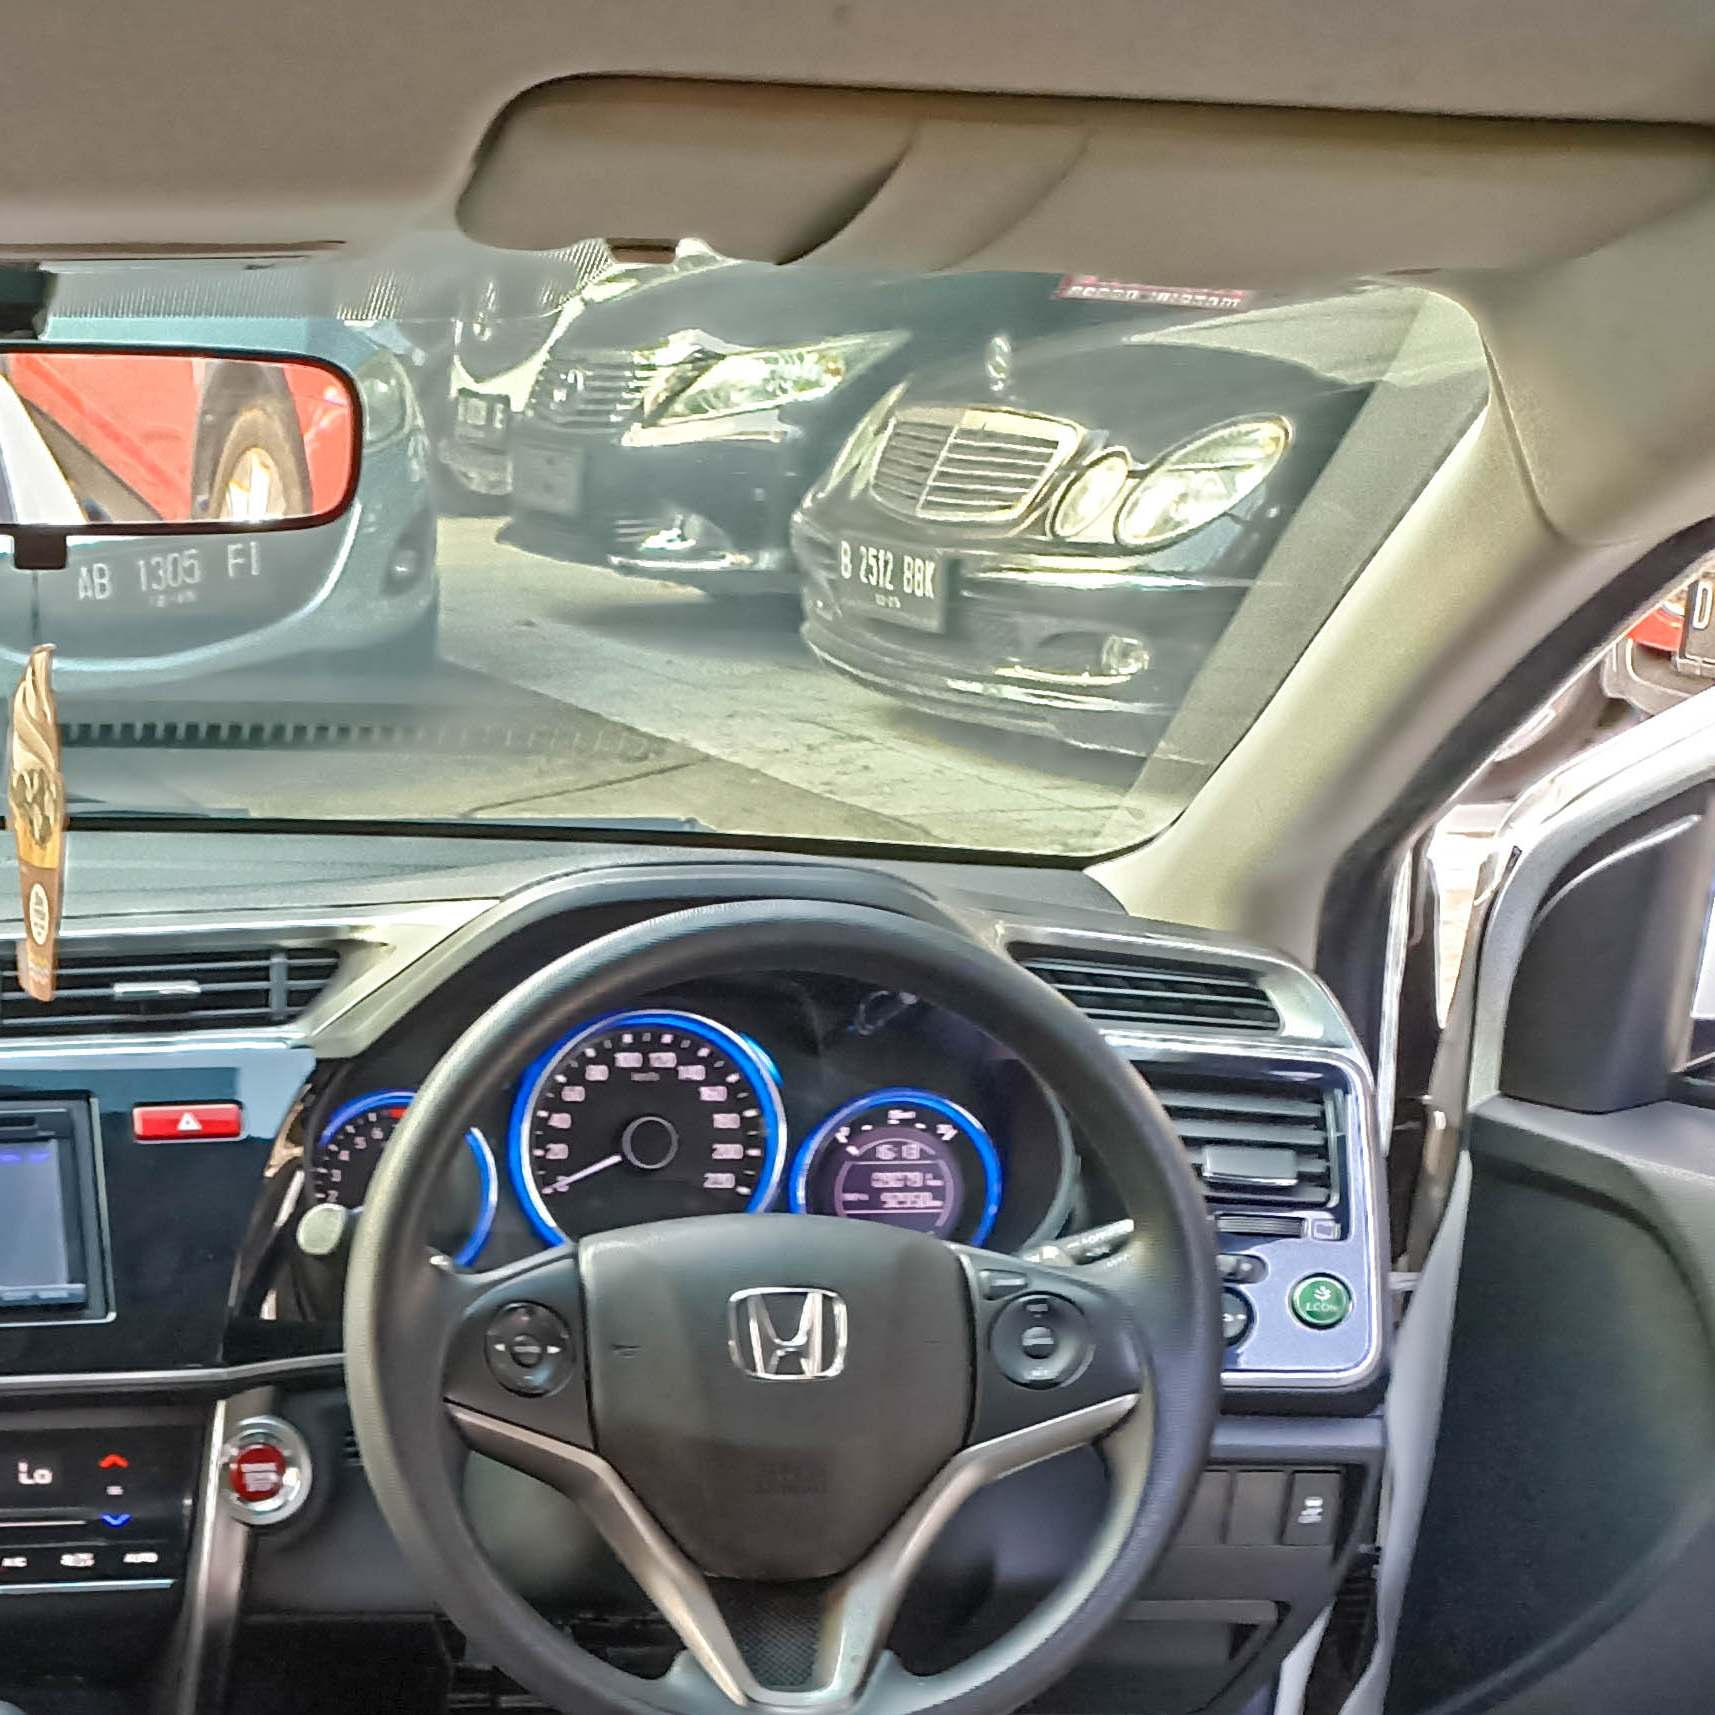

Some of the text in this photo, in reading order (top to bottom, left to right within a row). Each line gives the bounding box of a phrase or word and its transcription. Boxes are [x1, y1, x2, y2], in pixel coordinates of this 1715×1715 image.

[78, 563, 111, 600] AB
[138, 548, 201, 592] 1305
[859, 545, 894, 591] 2512
[903, 555, 936, 600] BBK
